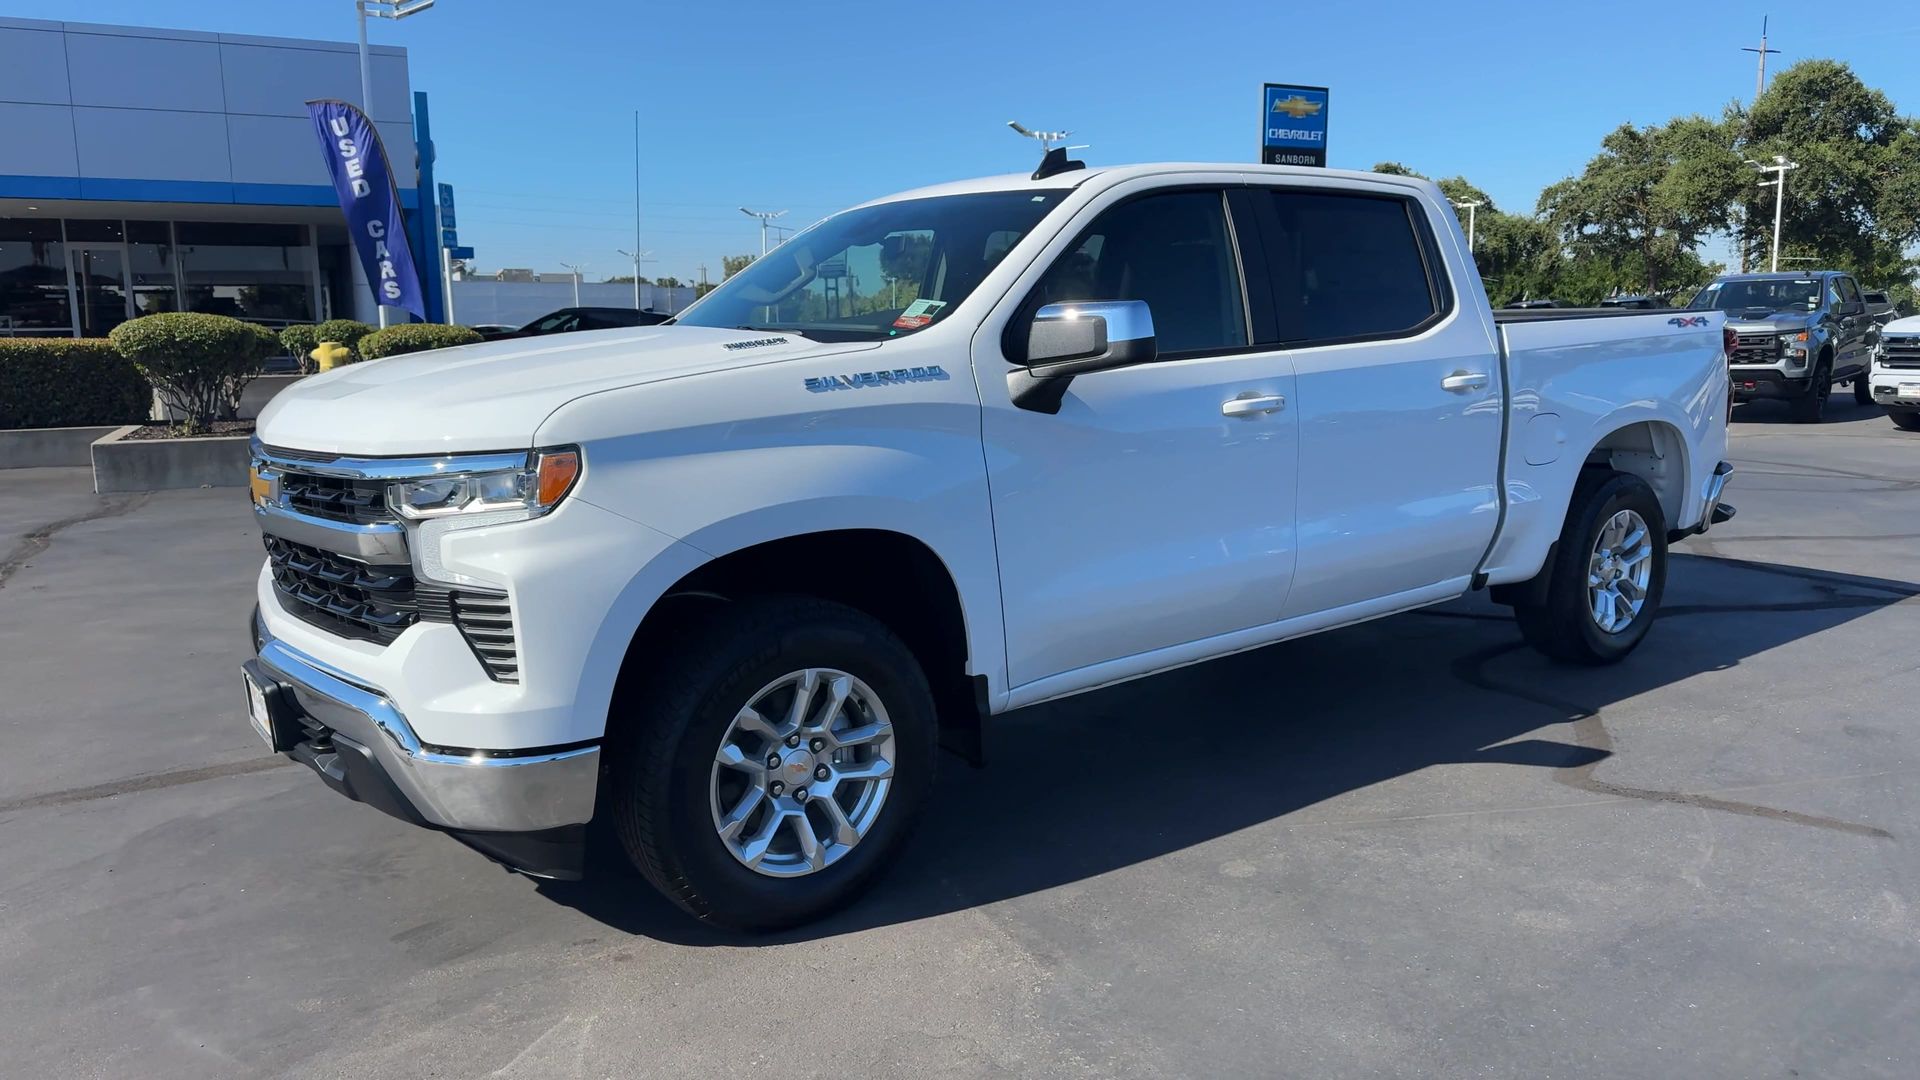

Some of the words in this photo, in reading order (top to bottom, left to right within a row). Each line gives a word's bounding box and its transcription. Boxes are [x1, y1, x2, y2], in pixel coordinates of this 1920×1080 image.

[1268, 128, 1323, 141] CHEVROLET
[1275, 153, 1316, 165] SANBORN
[330, 116, 371, 198] USED
[367, 219, 401, 299] CARS
[804, 364, 946, 390] SILVERADO
